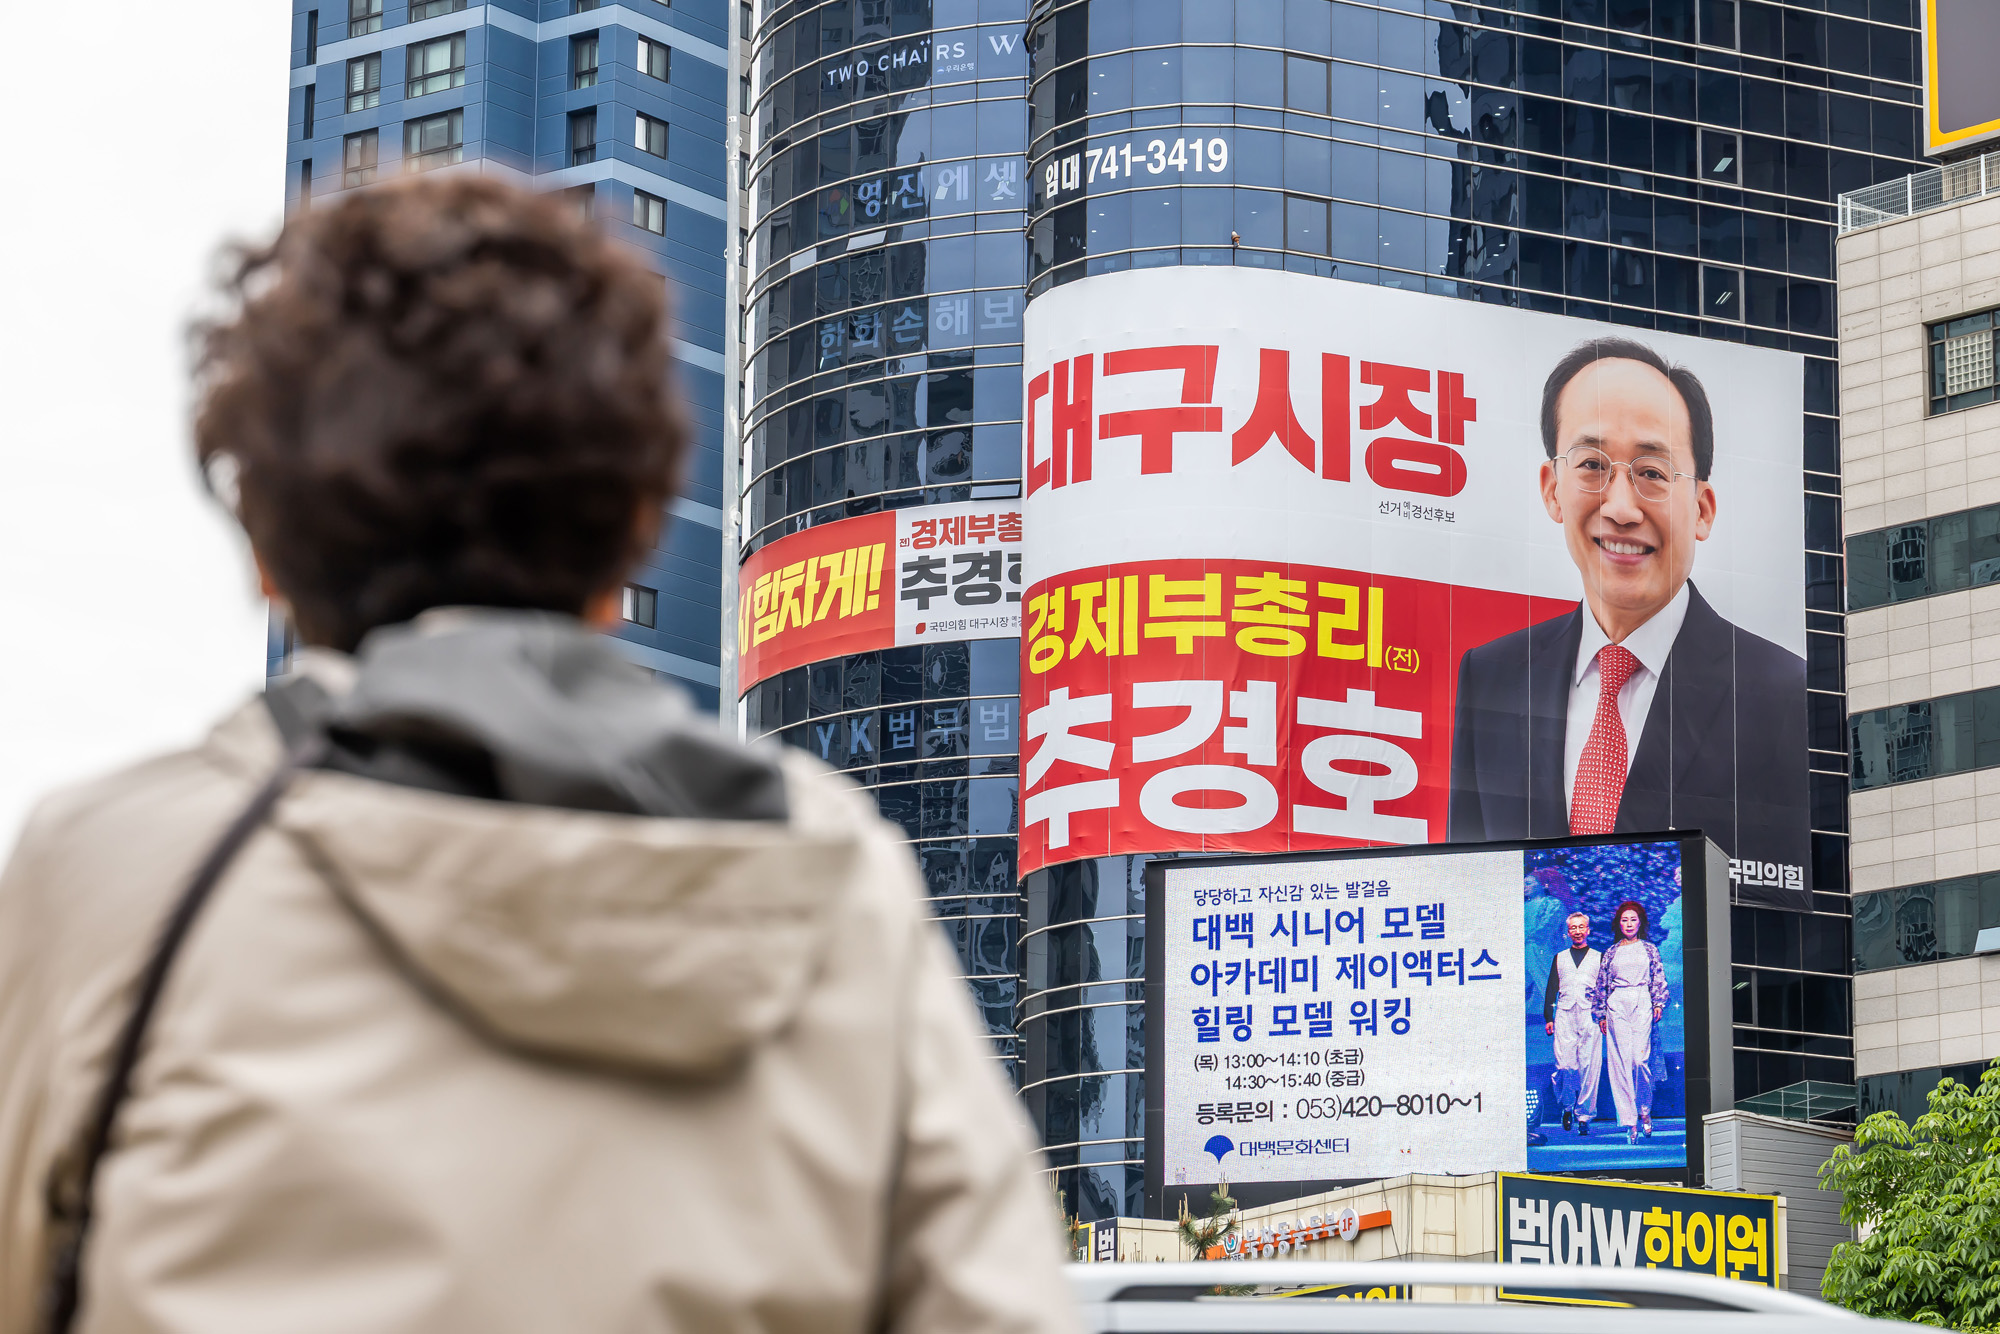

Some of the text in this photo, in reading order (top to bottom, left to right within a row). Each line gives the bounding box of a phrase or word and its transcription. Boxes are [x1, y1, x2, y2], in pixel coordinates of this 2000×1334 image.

[827, 60, 869, 86] TWO
[988, 33, 1020, 56] W
[945, 62, 975, 73] 우리은행
[857, 160, 1017, 217] 영진에셋
[1045, 137, 1228, 199] 임대 741-3419
[1026, 344, 1477, 501] 대구시장
[1378, 500, 1401, 516] 선거
[752, 542, 886, 648] 힘차게!
[929, 618, 967, 632] 국민의힘
[969, 616, 1009, 629] 대구시장
[1027, 571, 1421, 675] 경제부총리 (전)
[815, 715, 873, 759] YK
[1024, 679, 1429, 850] 추경호
[1193, 879, 1391, 907] 당당하고 자신감 있는 발걸음
[1728, 858, 1804, 891] 국민의힘
[1192, 902, 1446, 951] 대백 시니어 모델
[1190, 948, 1502, 997] 아카데미 제이액터스
[1191, 997, 1412, 1043] 힐링 모델 워킹
[1193, 1048, 1364, 1072] (목) 13:00~14:10 (초급)
[1225, 1069, 1365, 1090] 14:30~15:40 (중급)
[1196, 1101, 1274, 1125] 등록문의
[1296, 1091, 1482, 1122] 053)420-8010~1
[1239, 1137, 1350, 1157] 대백문화센터
[1342, 1217, 1353, 1232] 1F
